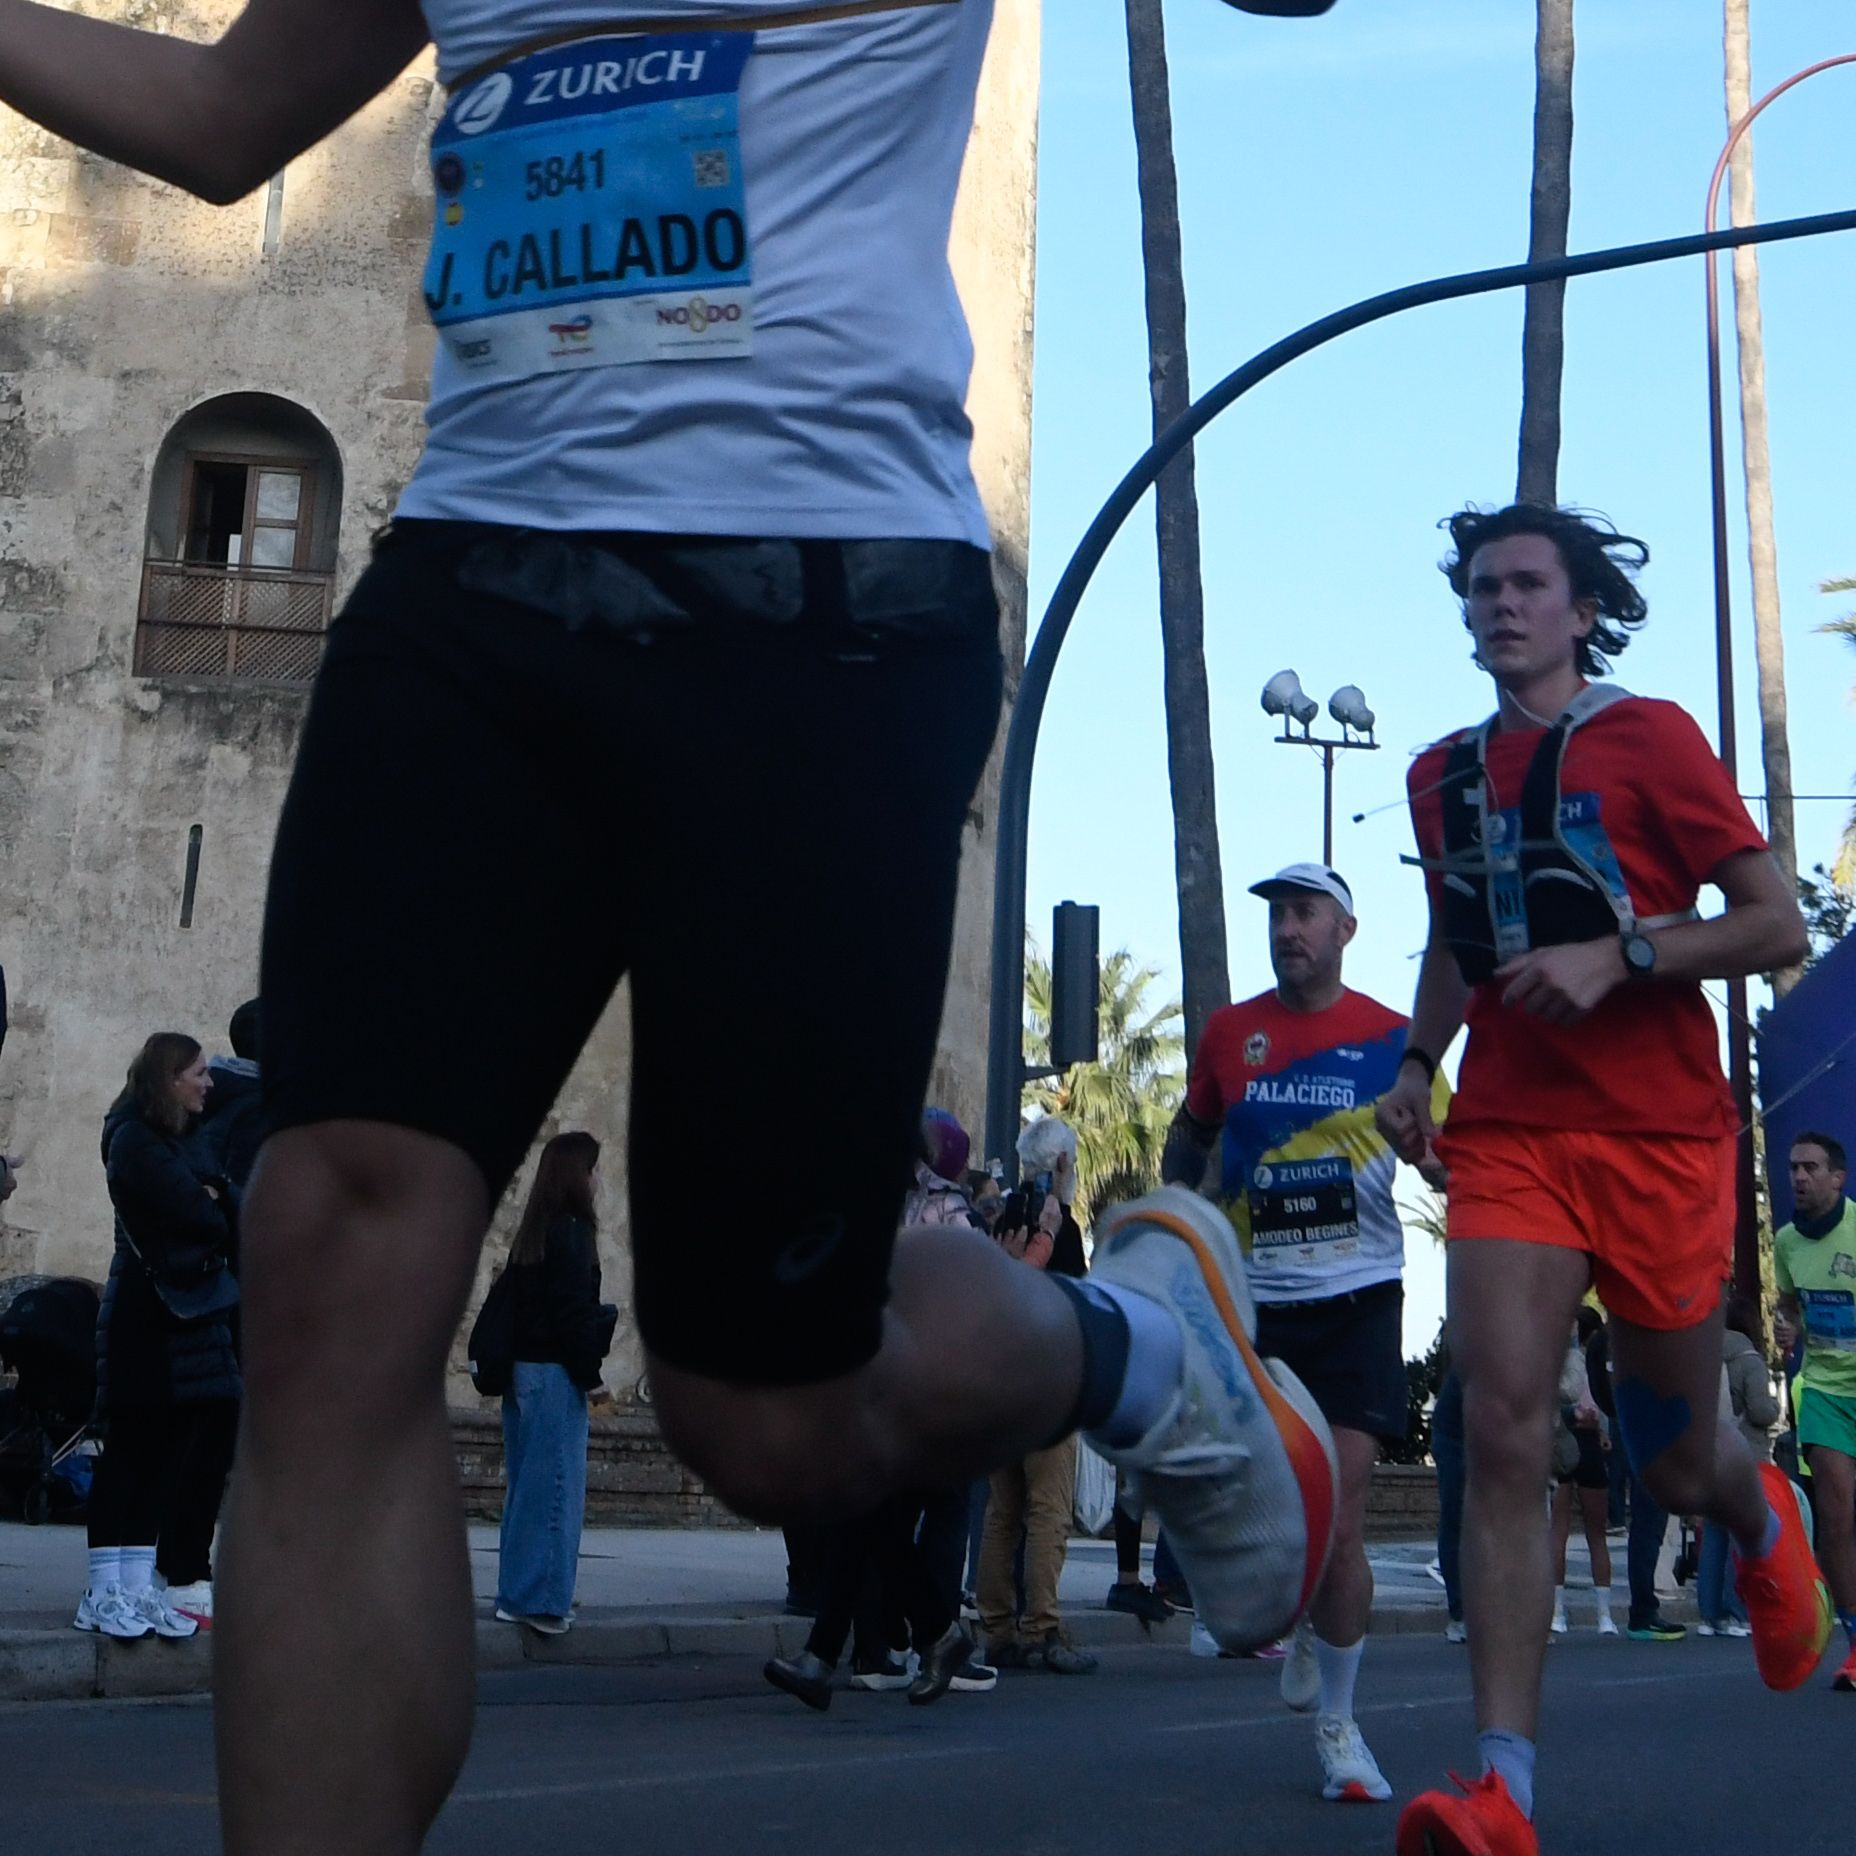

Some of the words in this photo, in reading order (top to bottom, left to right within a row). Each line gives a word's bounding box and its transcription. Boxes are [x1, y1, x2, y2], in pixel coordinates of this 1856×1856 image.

[524, 49, 706, 106] ZURICH
[525, 149, 606, 202] 5841
[483, 207, 746, 301] CALLADO
[1244, 1080, 1356, 1109] PALACIEGO
[1279, 1163, 1340, 1183] ZURICH
[1282, 1196, 1318, 1214] 5160
[1253, 1227, 1303, 1245] AMODEO
